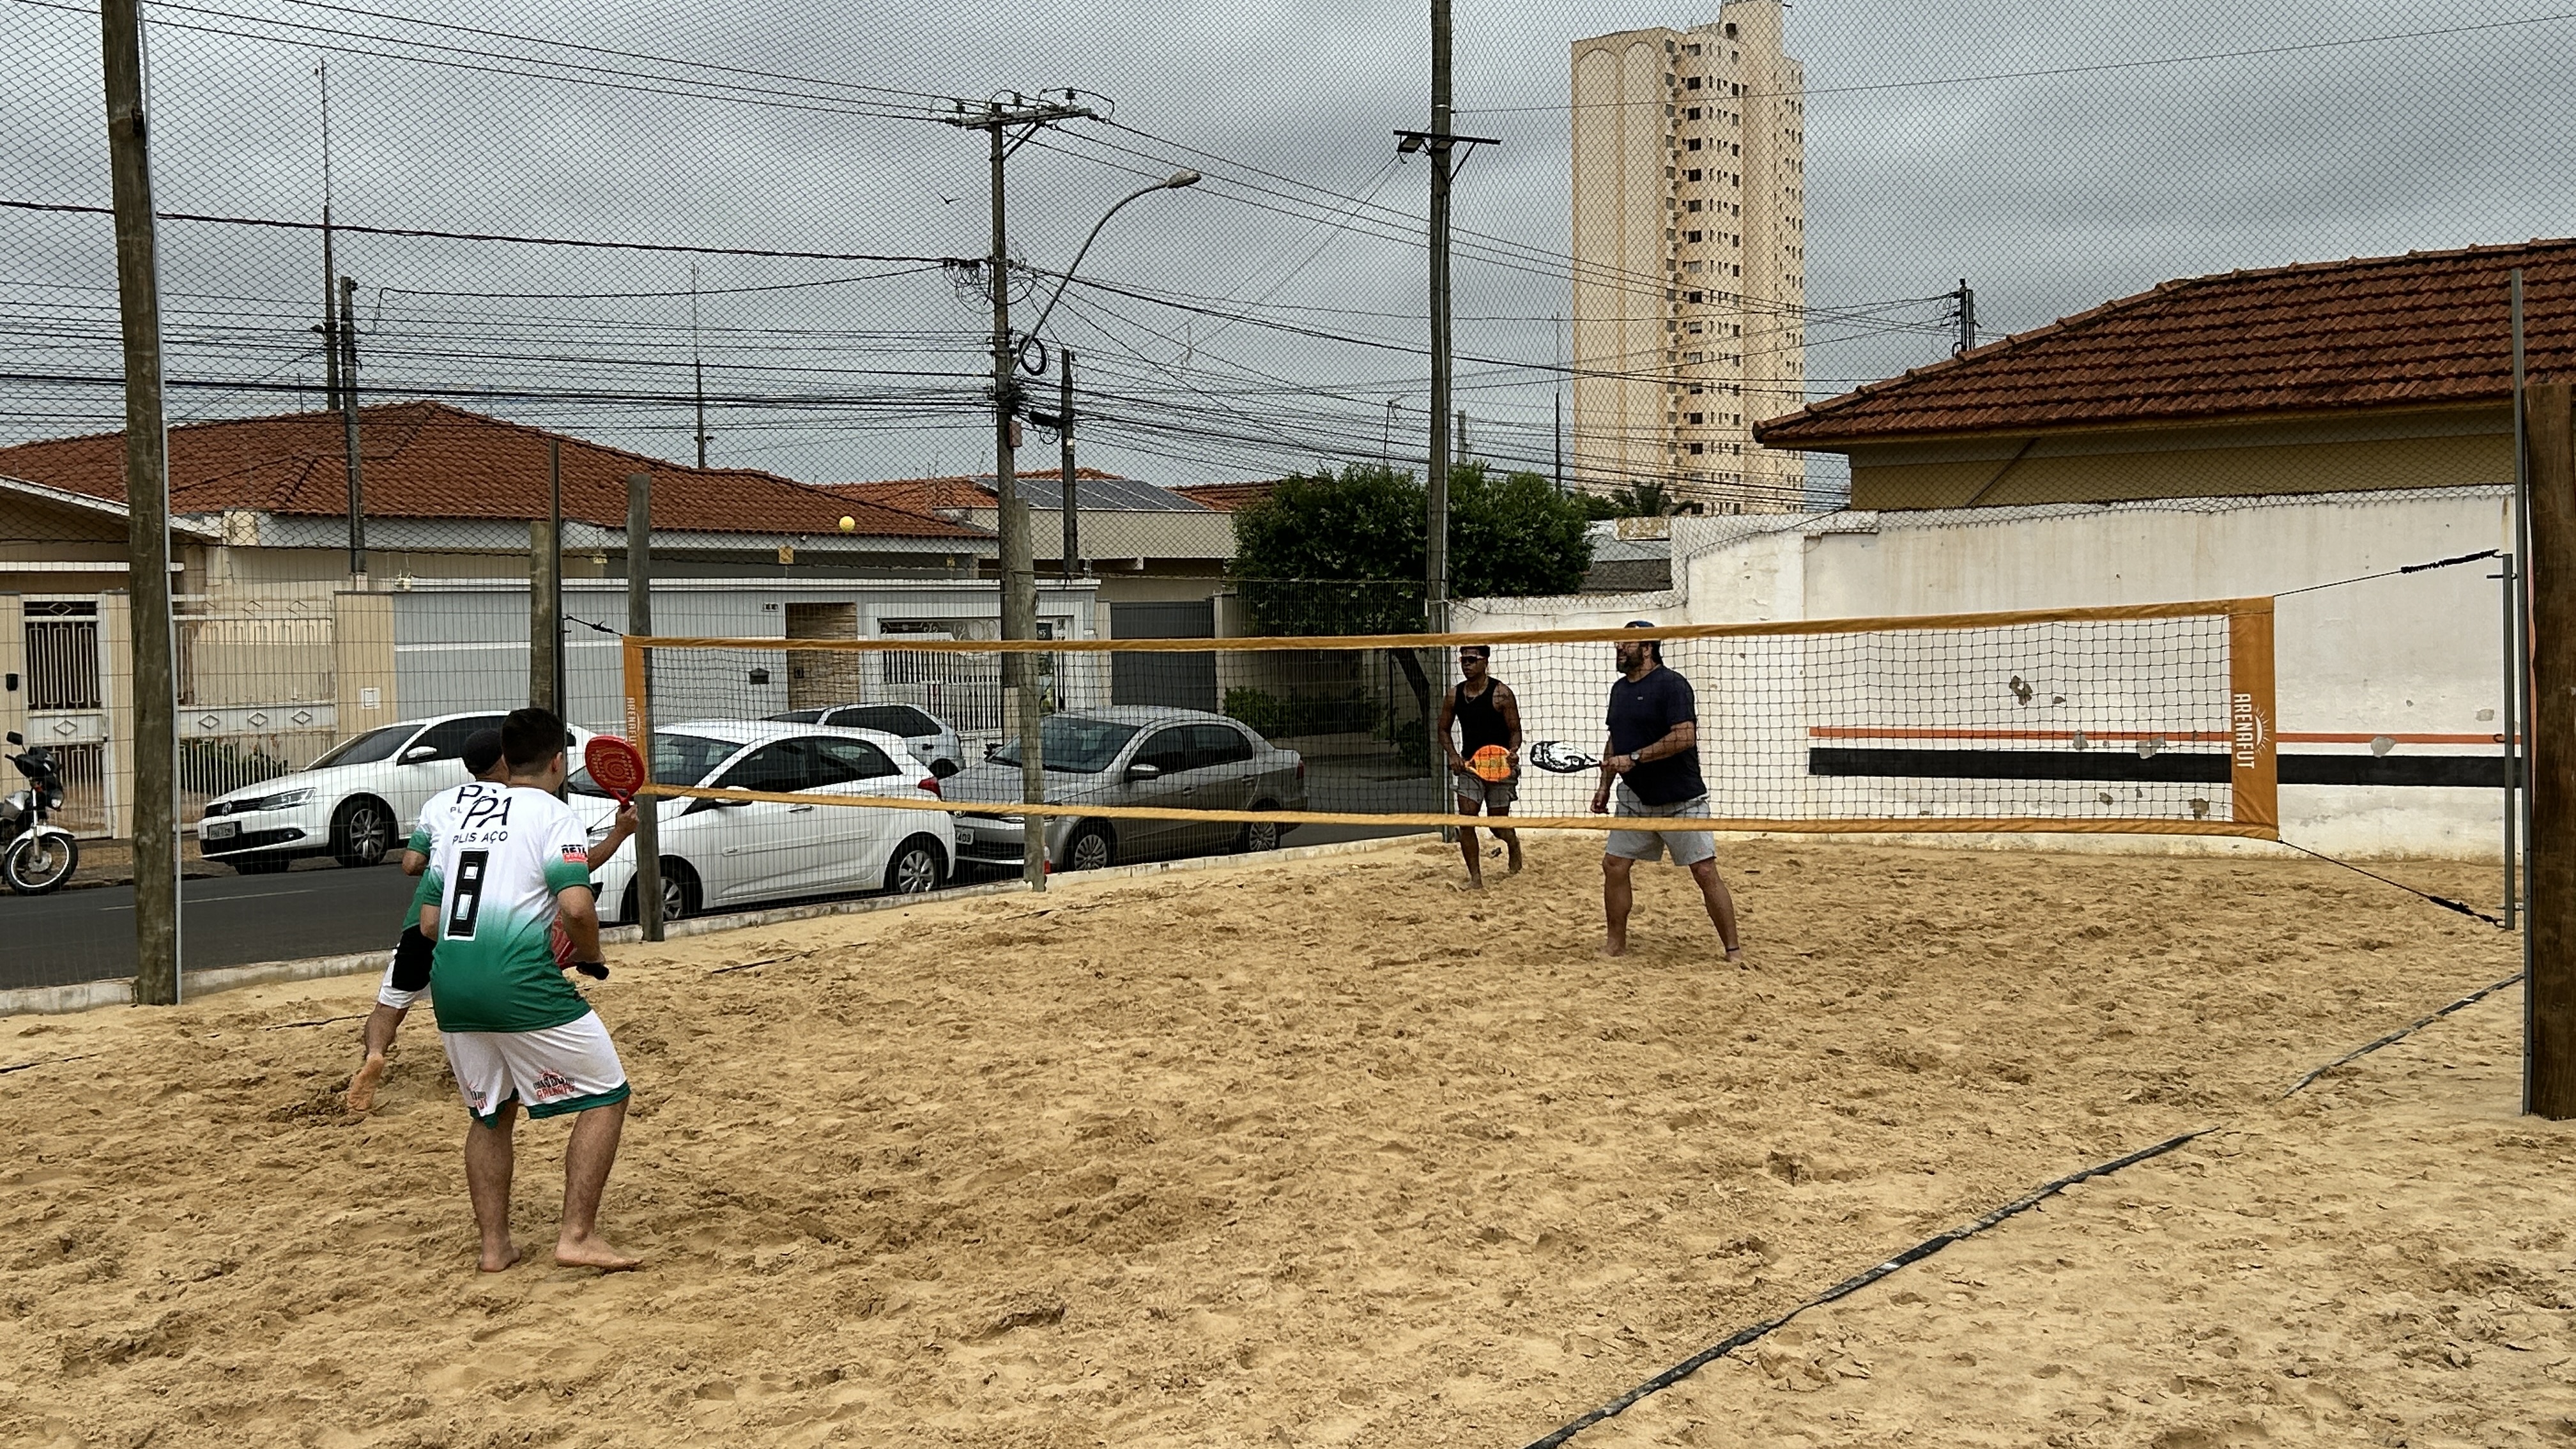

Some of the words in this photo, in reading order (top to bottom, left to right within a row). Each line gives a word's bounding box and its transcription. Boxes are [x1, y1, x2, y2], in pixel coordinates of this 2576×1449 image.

[2234, 693, 2255, 769] ARENAFUT
[452, 832, 477, 846] PLIS
[480, 831, 509, 844] AÇO
[445, 848, 489, 940] 8
